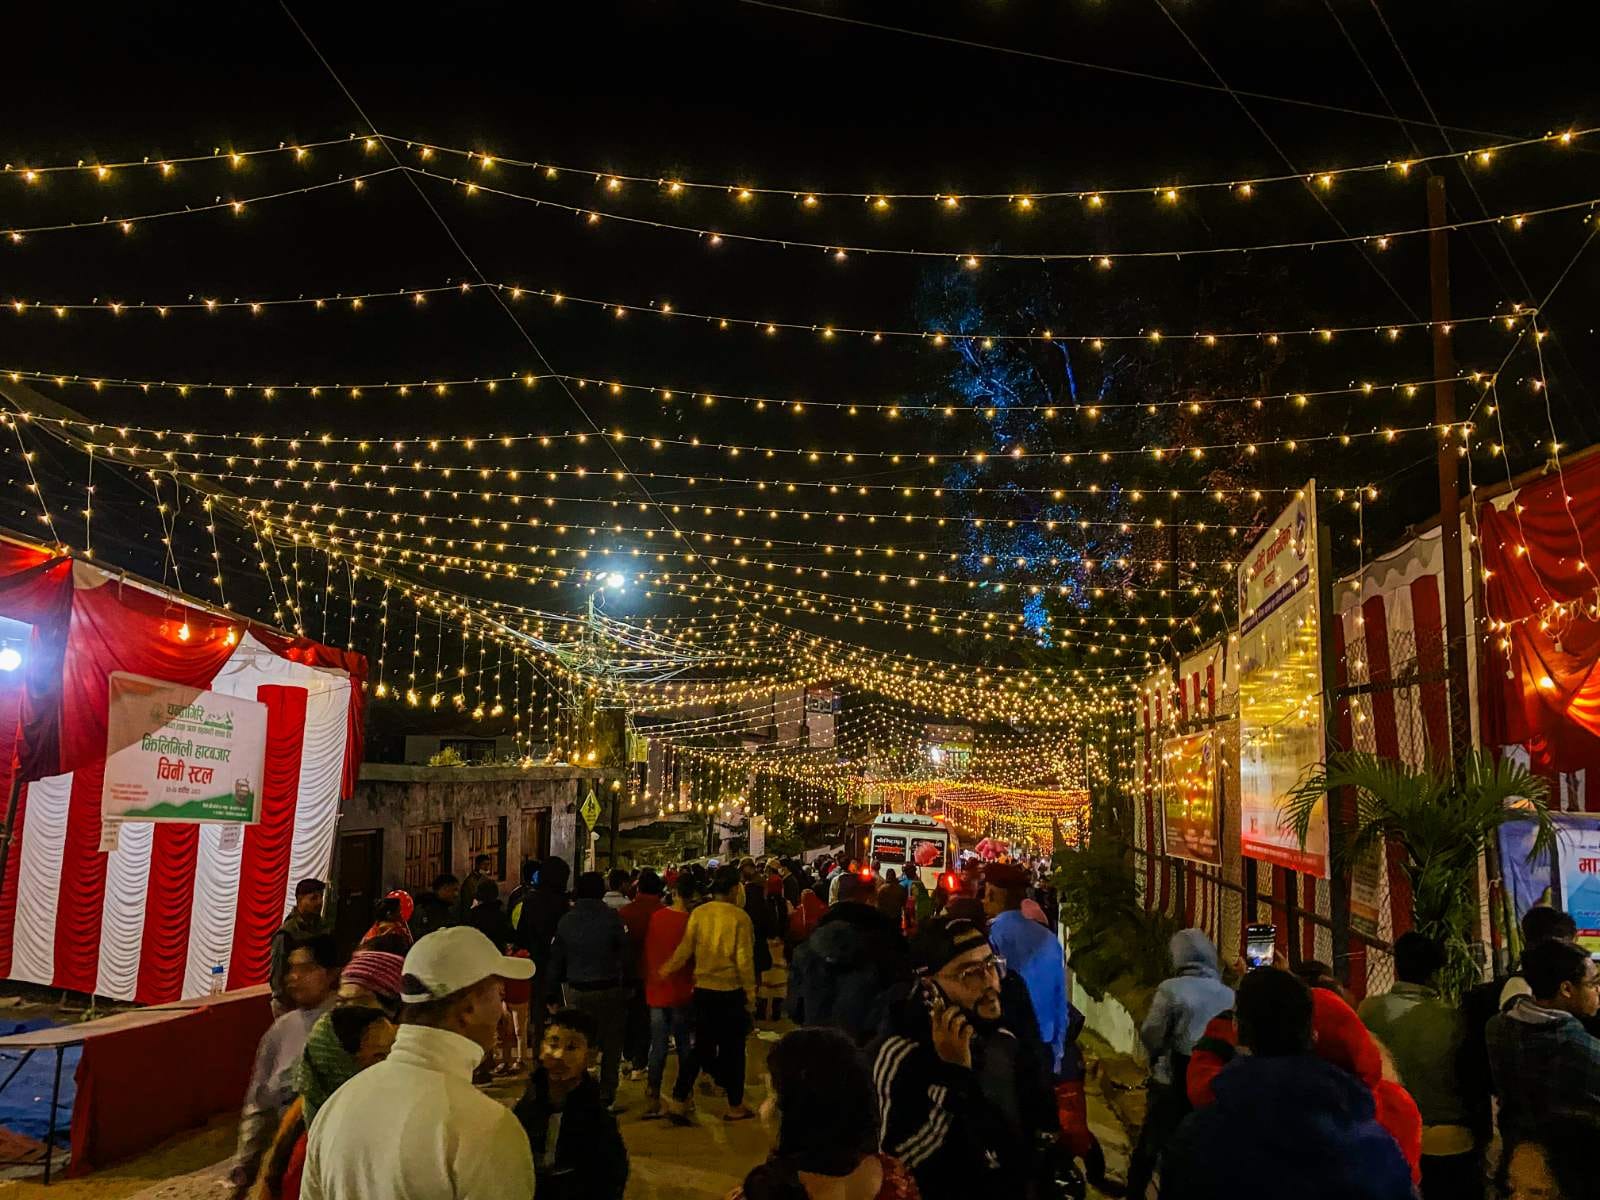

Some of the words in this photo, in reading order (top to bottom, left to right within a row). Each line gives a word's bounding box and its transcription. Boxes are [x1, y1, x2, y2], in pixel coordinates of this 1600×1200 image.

[142, 733, 193, 757] झिलिमिली
[195, 744, 231, 763] हाटबजार
[157, 756, 185, 781] चिनी
[188, 766, 214, 785] स्टल
[1579, 857, 1600, 874] मा
